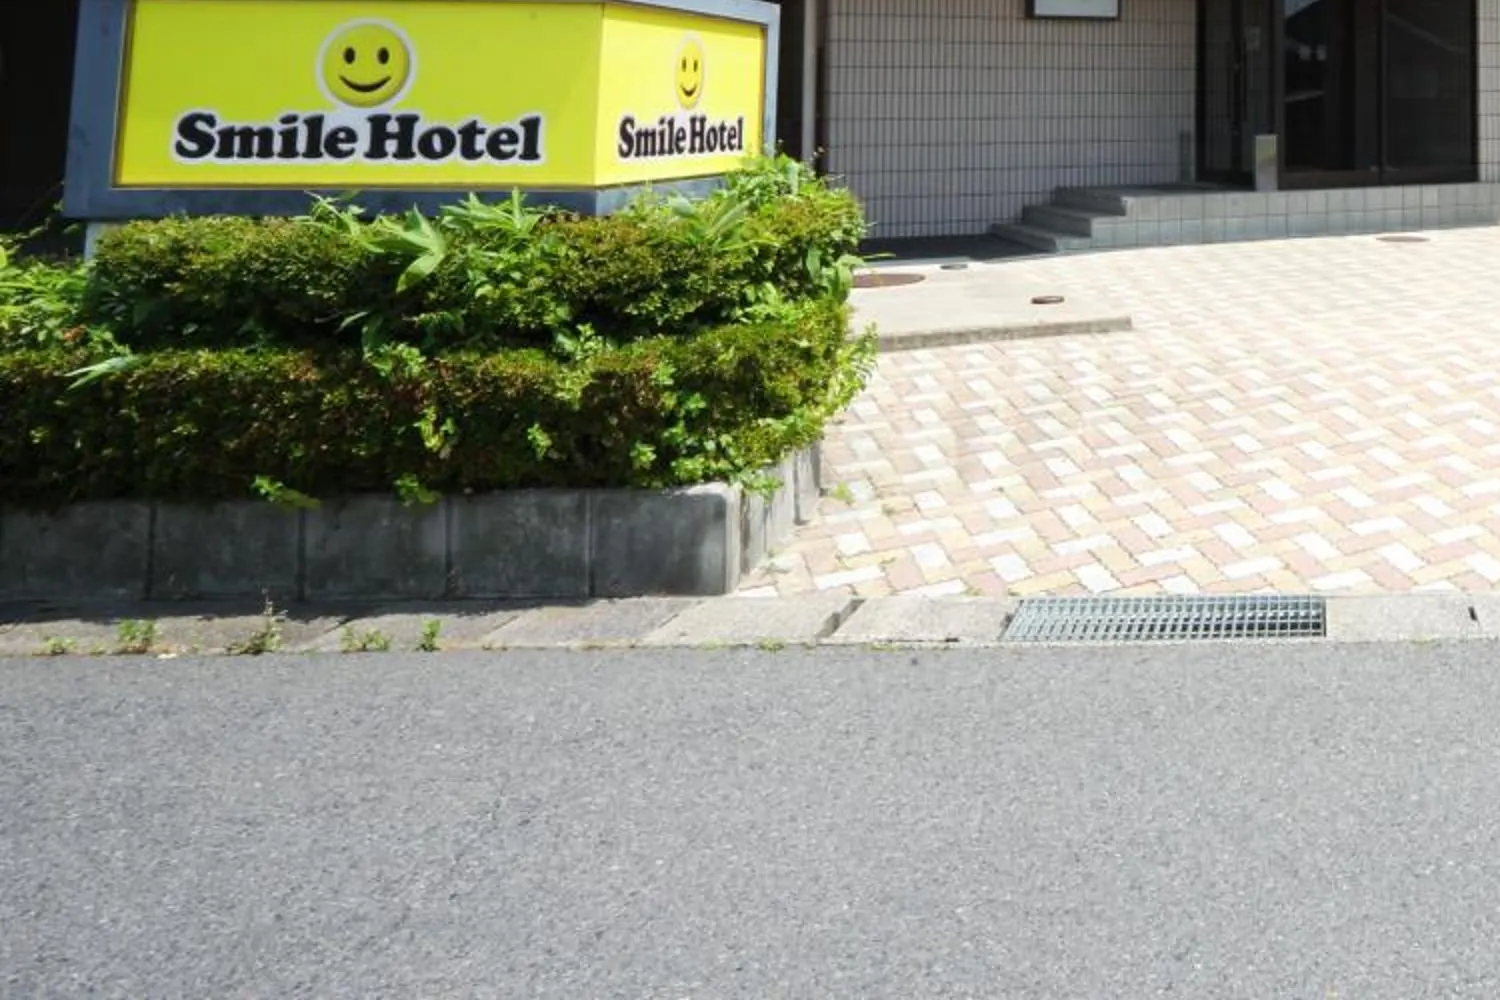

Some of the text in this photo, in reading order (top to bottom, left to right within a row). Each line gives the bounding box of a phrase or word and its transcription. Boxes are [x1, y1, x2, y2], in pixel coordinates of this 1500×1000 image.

[175, 111, 541, 161] Smile Hotel
[618, 114, 744, 158] Smile Hotel
